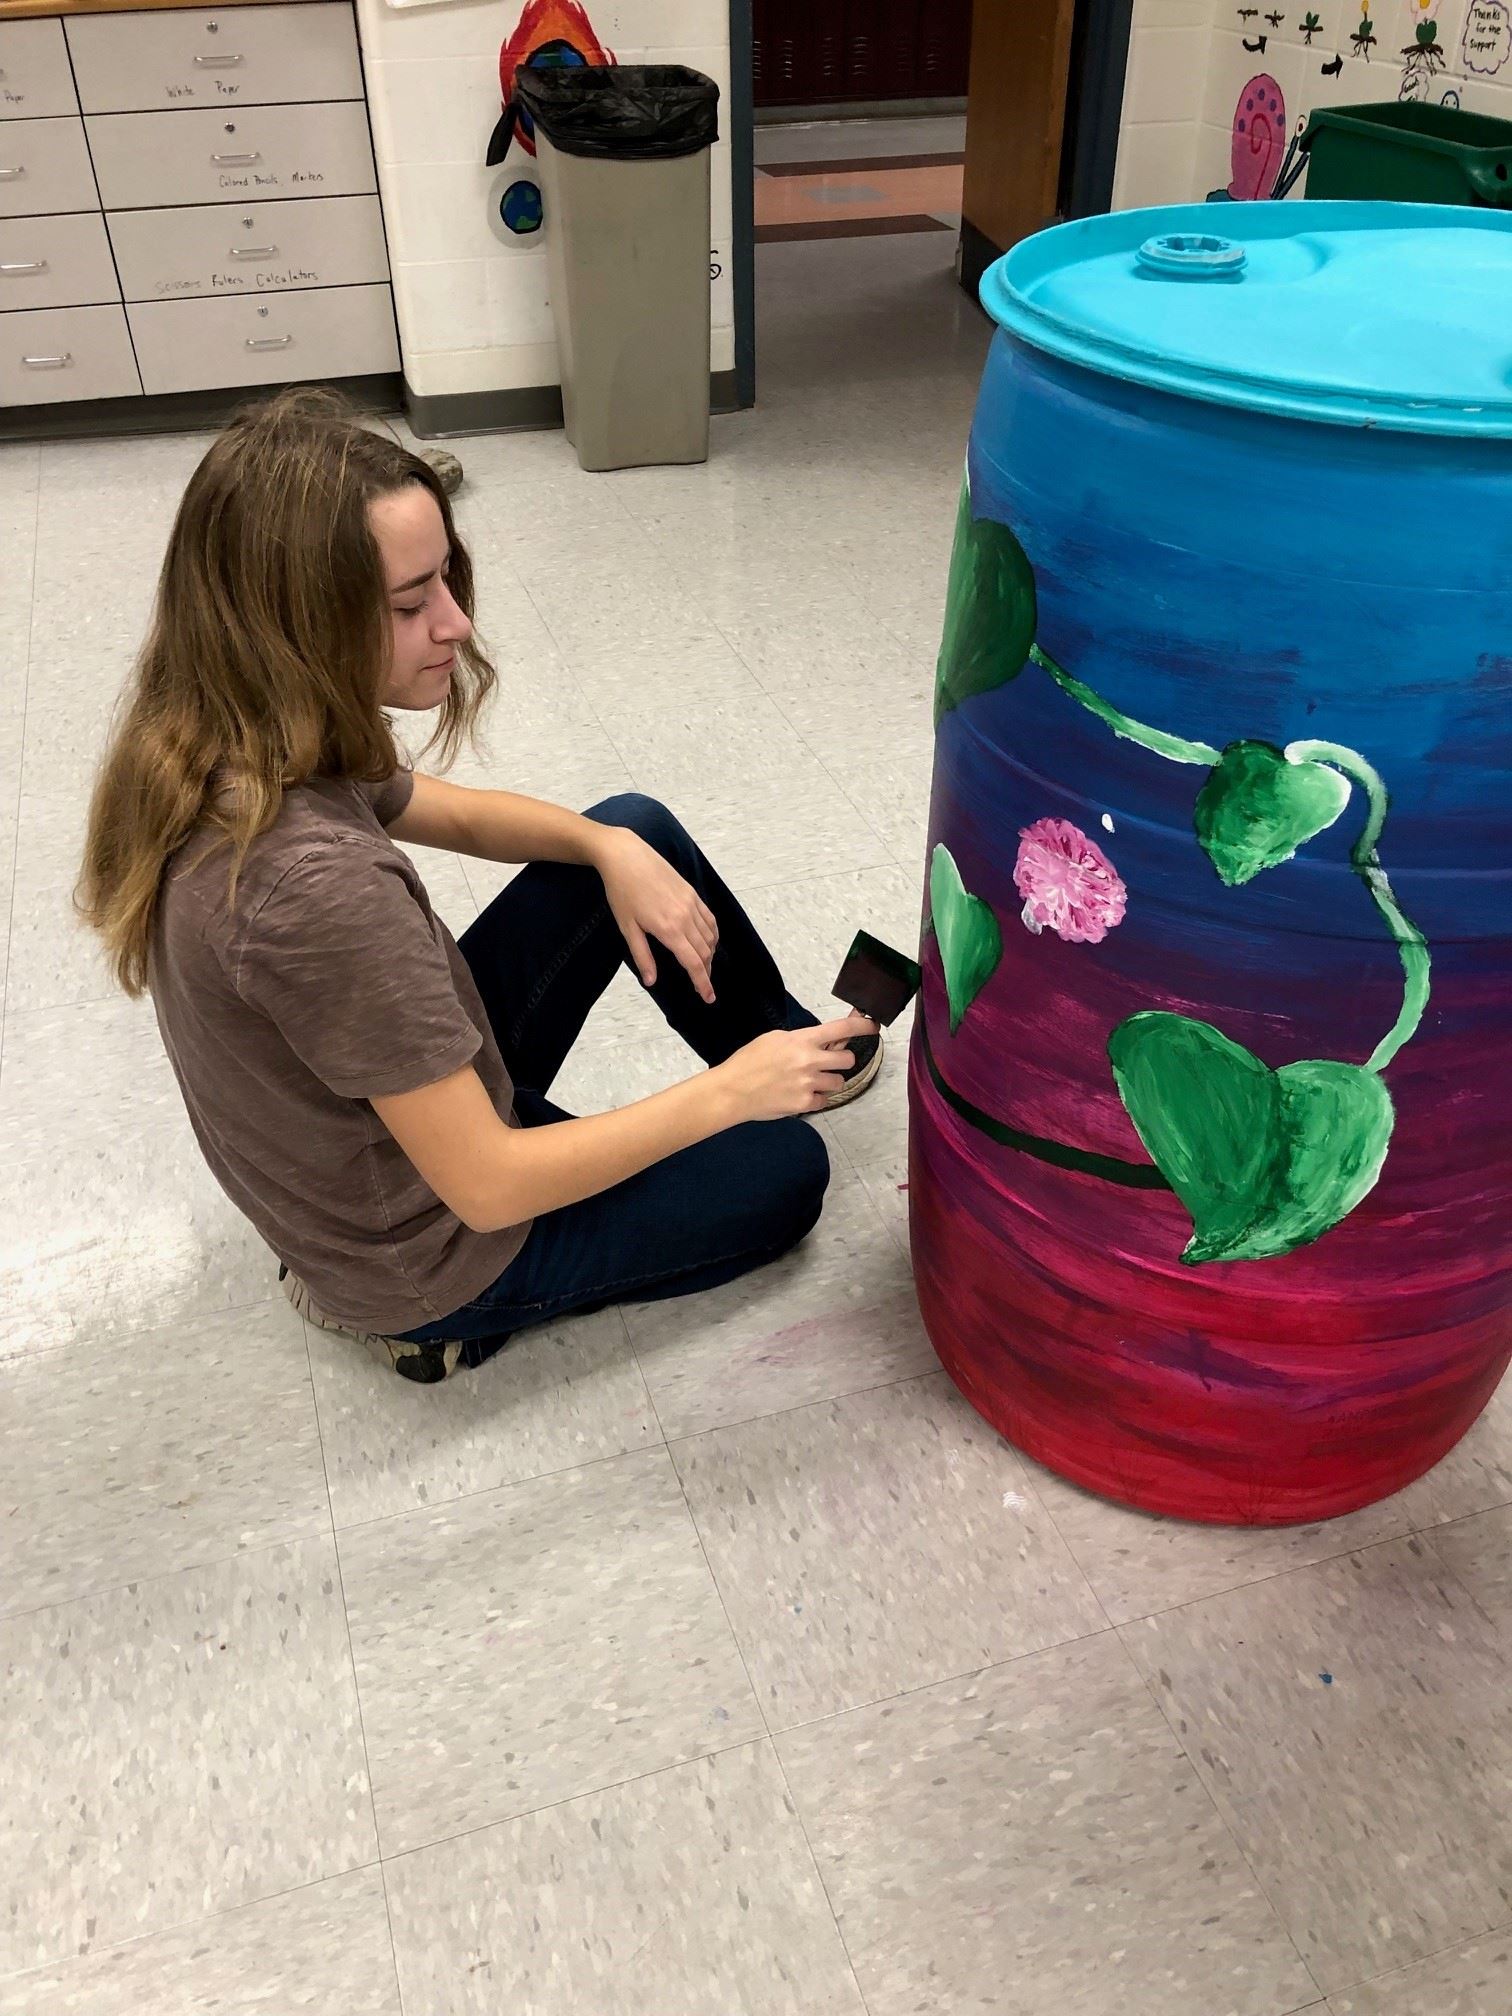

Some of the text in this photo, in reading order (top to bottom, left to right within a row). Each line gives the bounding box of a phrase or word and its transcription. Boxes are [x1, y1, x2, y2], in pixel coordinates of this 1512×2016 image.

[1473, 8, 1500, 20] Thanks
[1476, 22, 1501, 35] for the
[219, 175, 248, 188] Colored
[292, 171, 324, 182] Markers
[256, 269, 319, 287] Calculators
